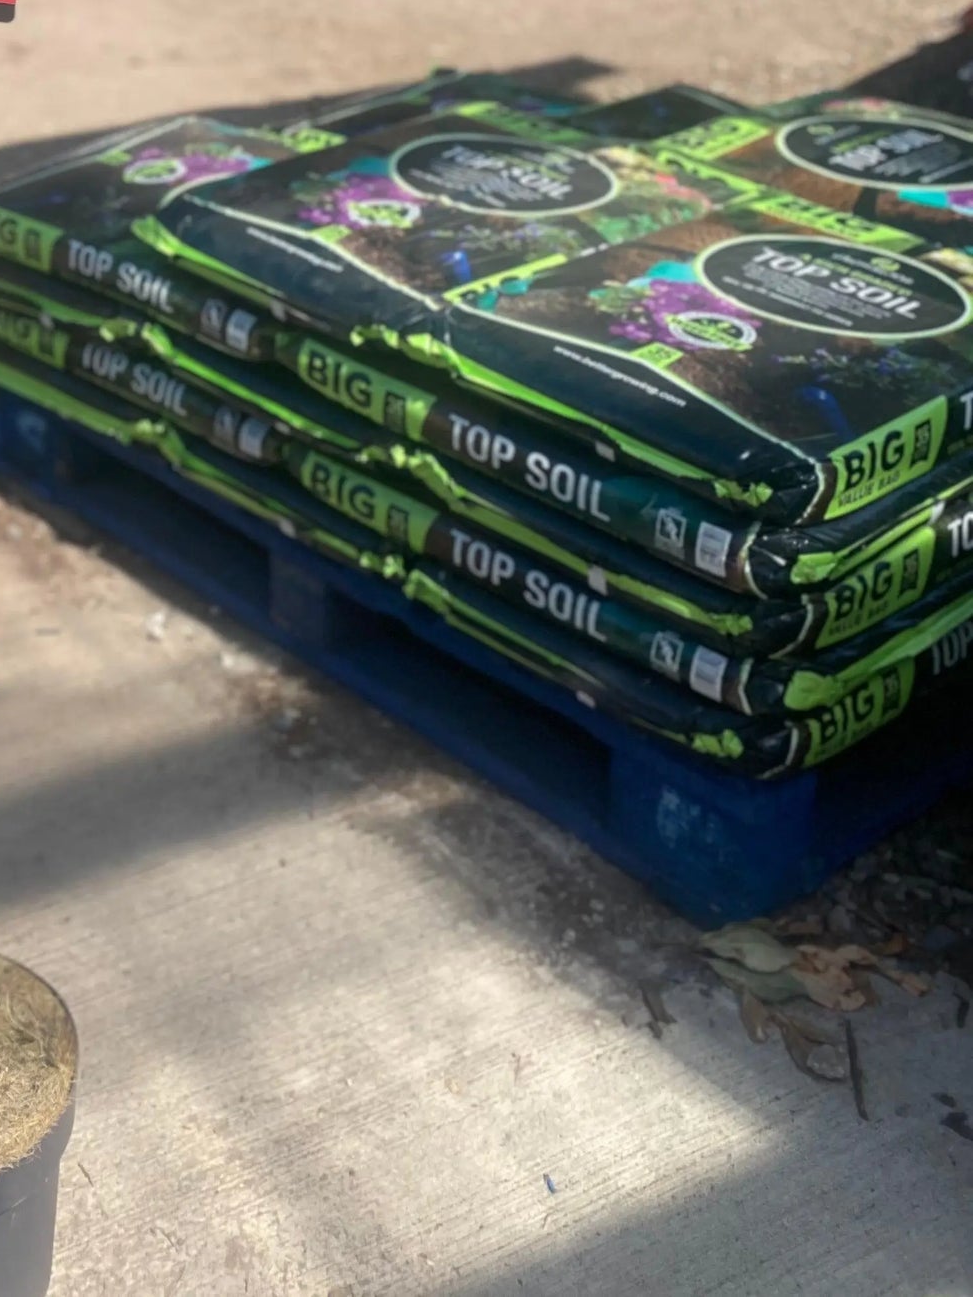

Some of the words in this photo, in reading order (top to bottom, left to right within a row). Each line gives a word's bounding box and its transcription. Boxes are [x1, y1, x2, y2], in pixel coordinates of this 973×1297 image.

[68, 238, 114, 282] TOP
[116, 261, 174, 314] SOIL
[752, 245, 831, 278] TOP
[829, 276, 921, 320] SOIL
[131, 362, 187, 417] SOIL
[308, 349, 373, 410] BIG
[448, 411, 516, 470] TOP
[525, 451, 611, 523] SOIL
[843, 429, 905, 492] BIG
[310, 461, 376, 520] BIG
[449, 528, 516, 586] TOP
[523, 569, 607, 643] SOIL
[835, 561, 893, 621] BIG
[819, 678, 875, 745] BIG
